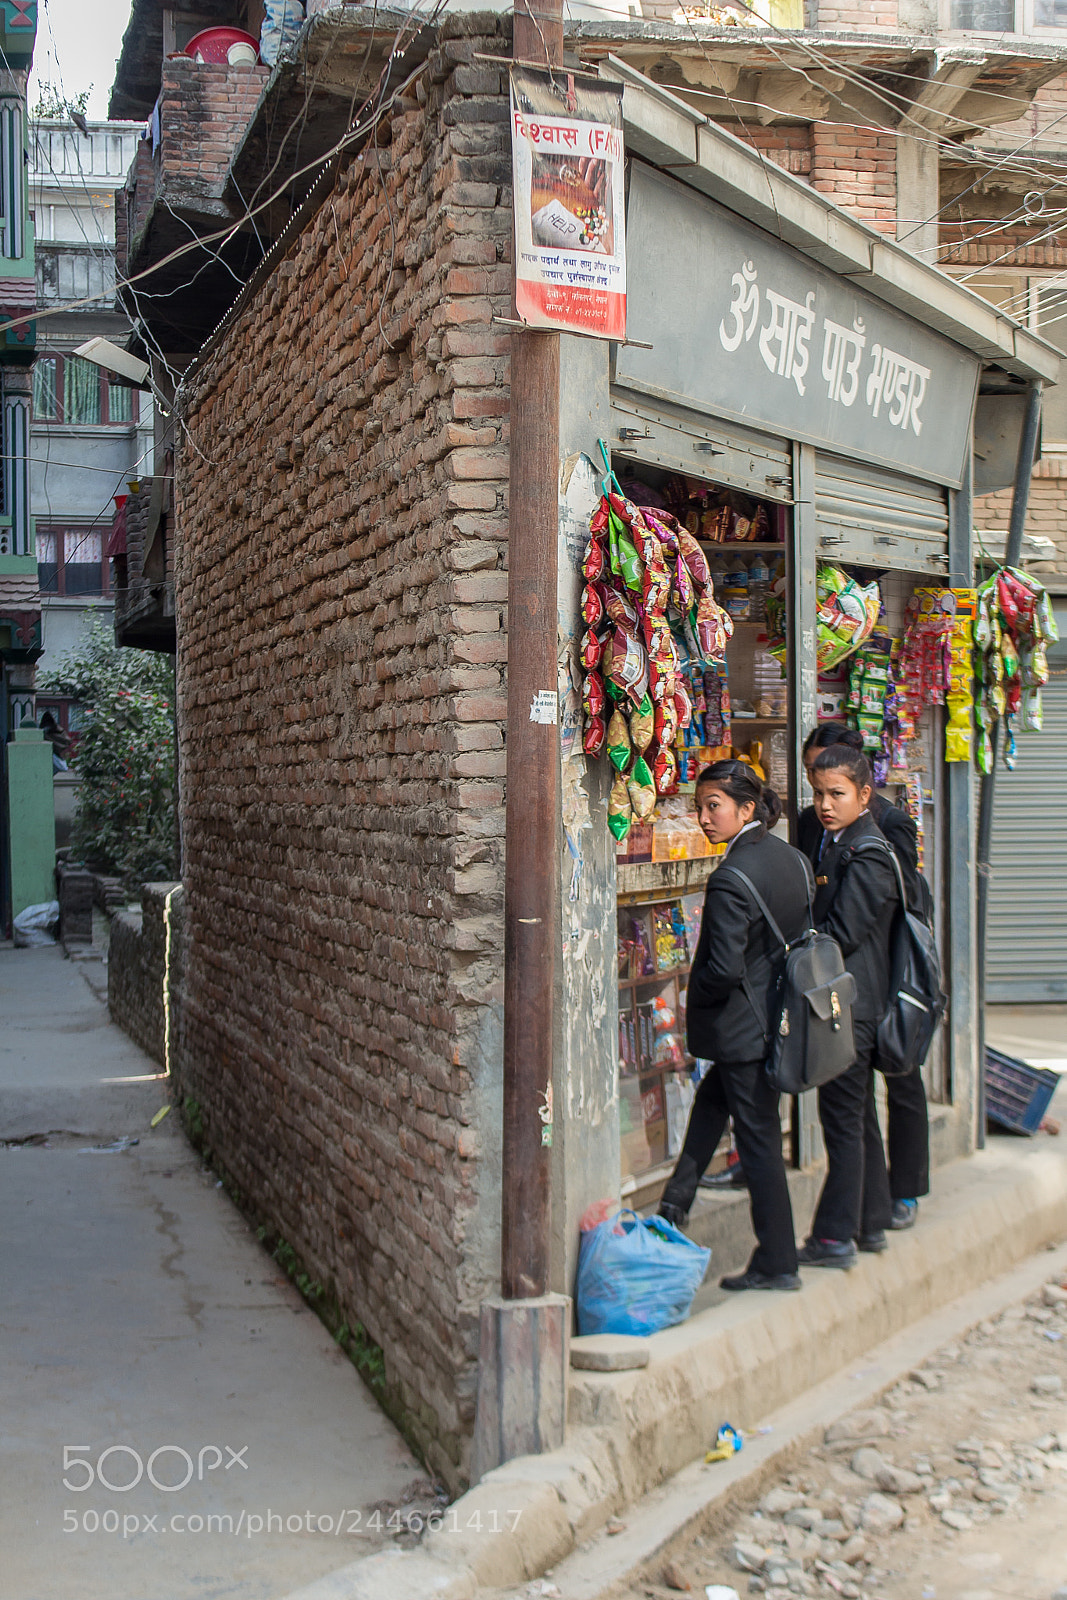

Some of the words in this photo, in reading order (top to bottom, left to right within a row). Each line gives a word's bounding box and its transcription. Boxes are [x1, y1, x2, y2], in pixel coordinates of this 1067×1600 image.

[548, 213, 577, 235] HELP
[541, 255, 559, 266] पदार्थ
[562, 258, 577, 267] तथा
[821, 316, 867, 407] पाउँ
[866, 343, 932, 437] भण्डार
